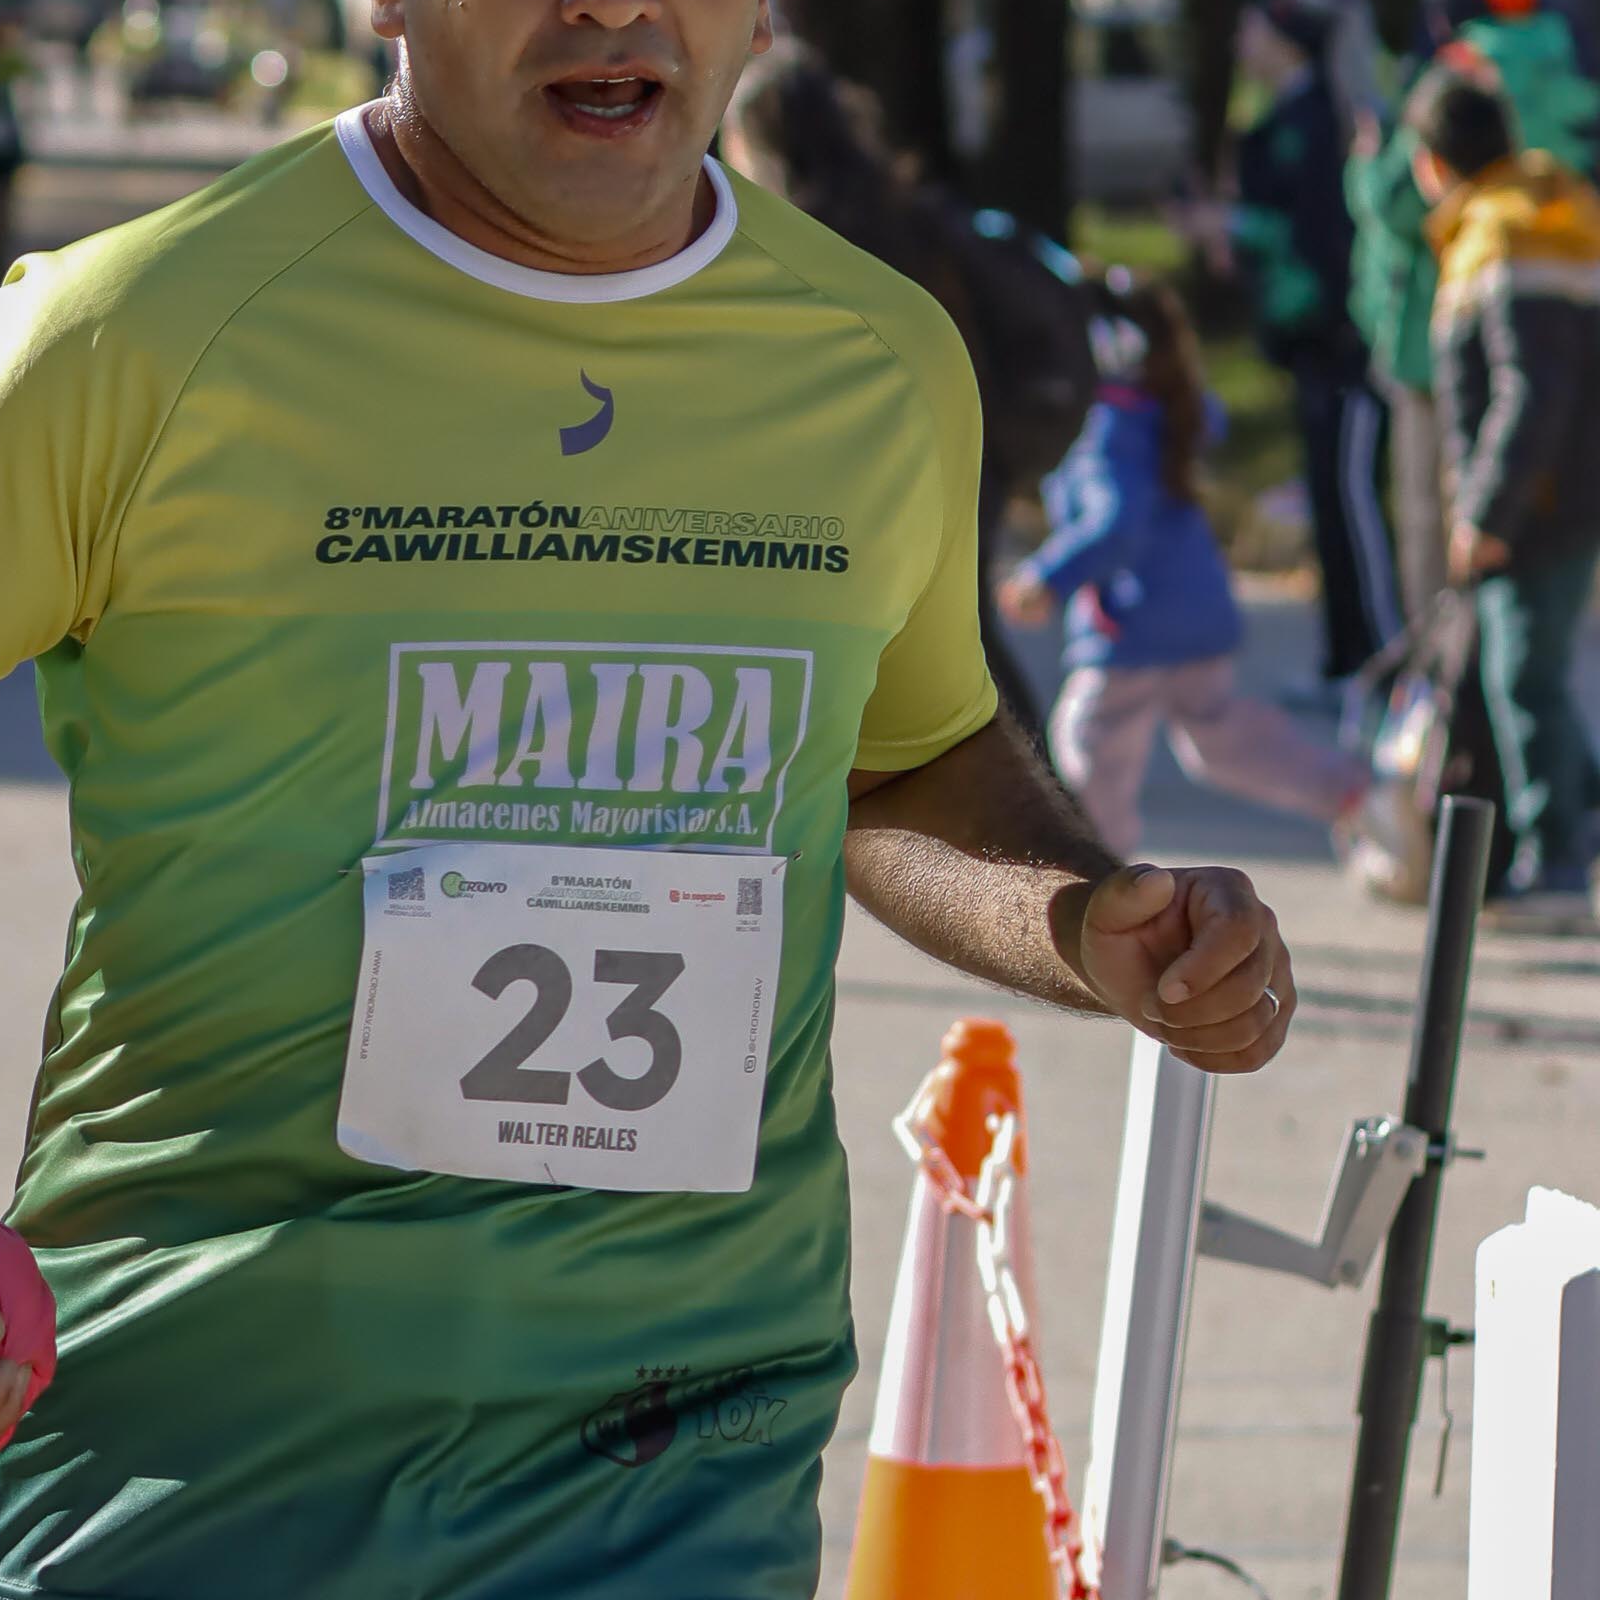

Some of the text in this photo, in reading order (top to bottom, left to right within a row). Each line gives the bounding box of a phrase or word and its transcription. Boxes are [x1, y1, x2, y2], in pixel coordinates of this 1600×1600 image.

[315, 532, 849, 573] CAWILLIAMSKEMMIS
[409, 661, 773, 794] MAIRA
[399, 800, 561, 833] Almacenes
[459, 943, 686, 1111] 23
[498, 1120, 638, 1152] WALTER REALES
